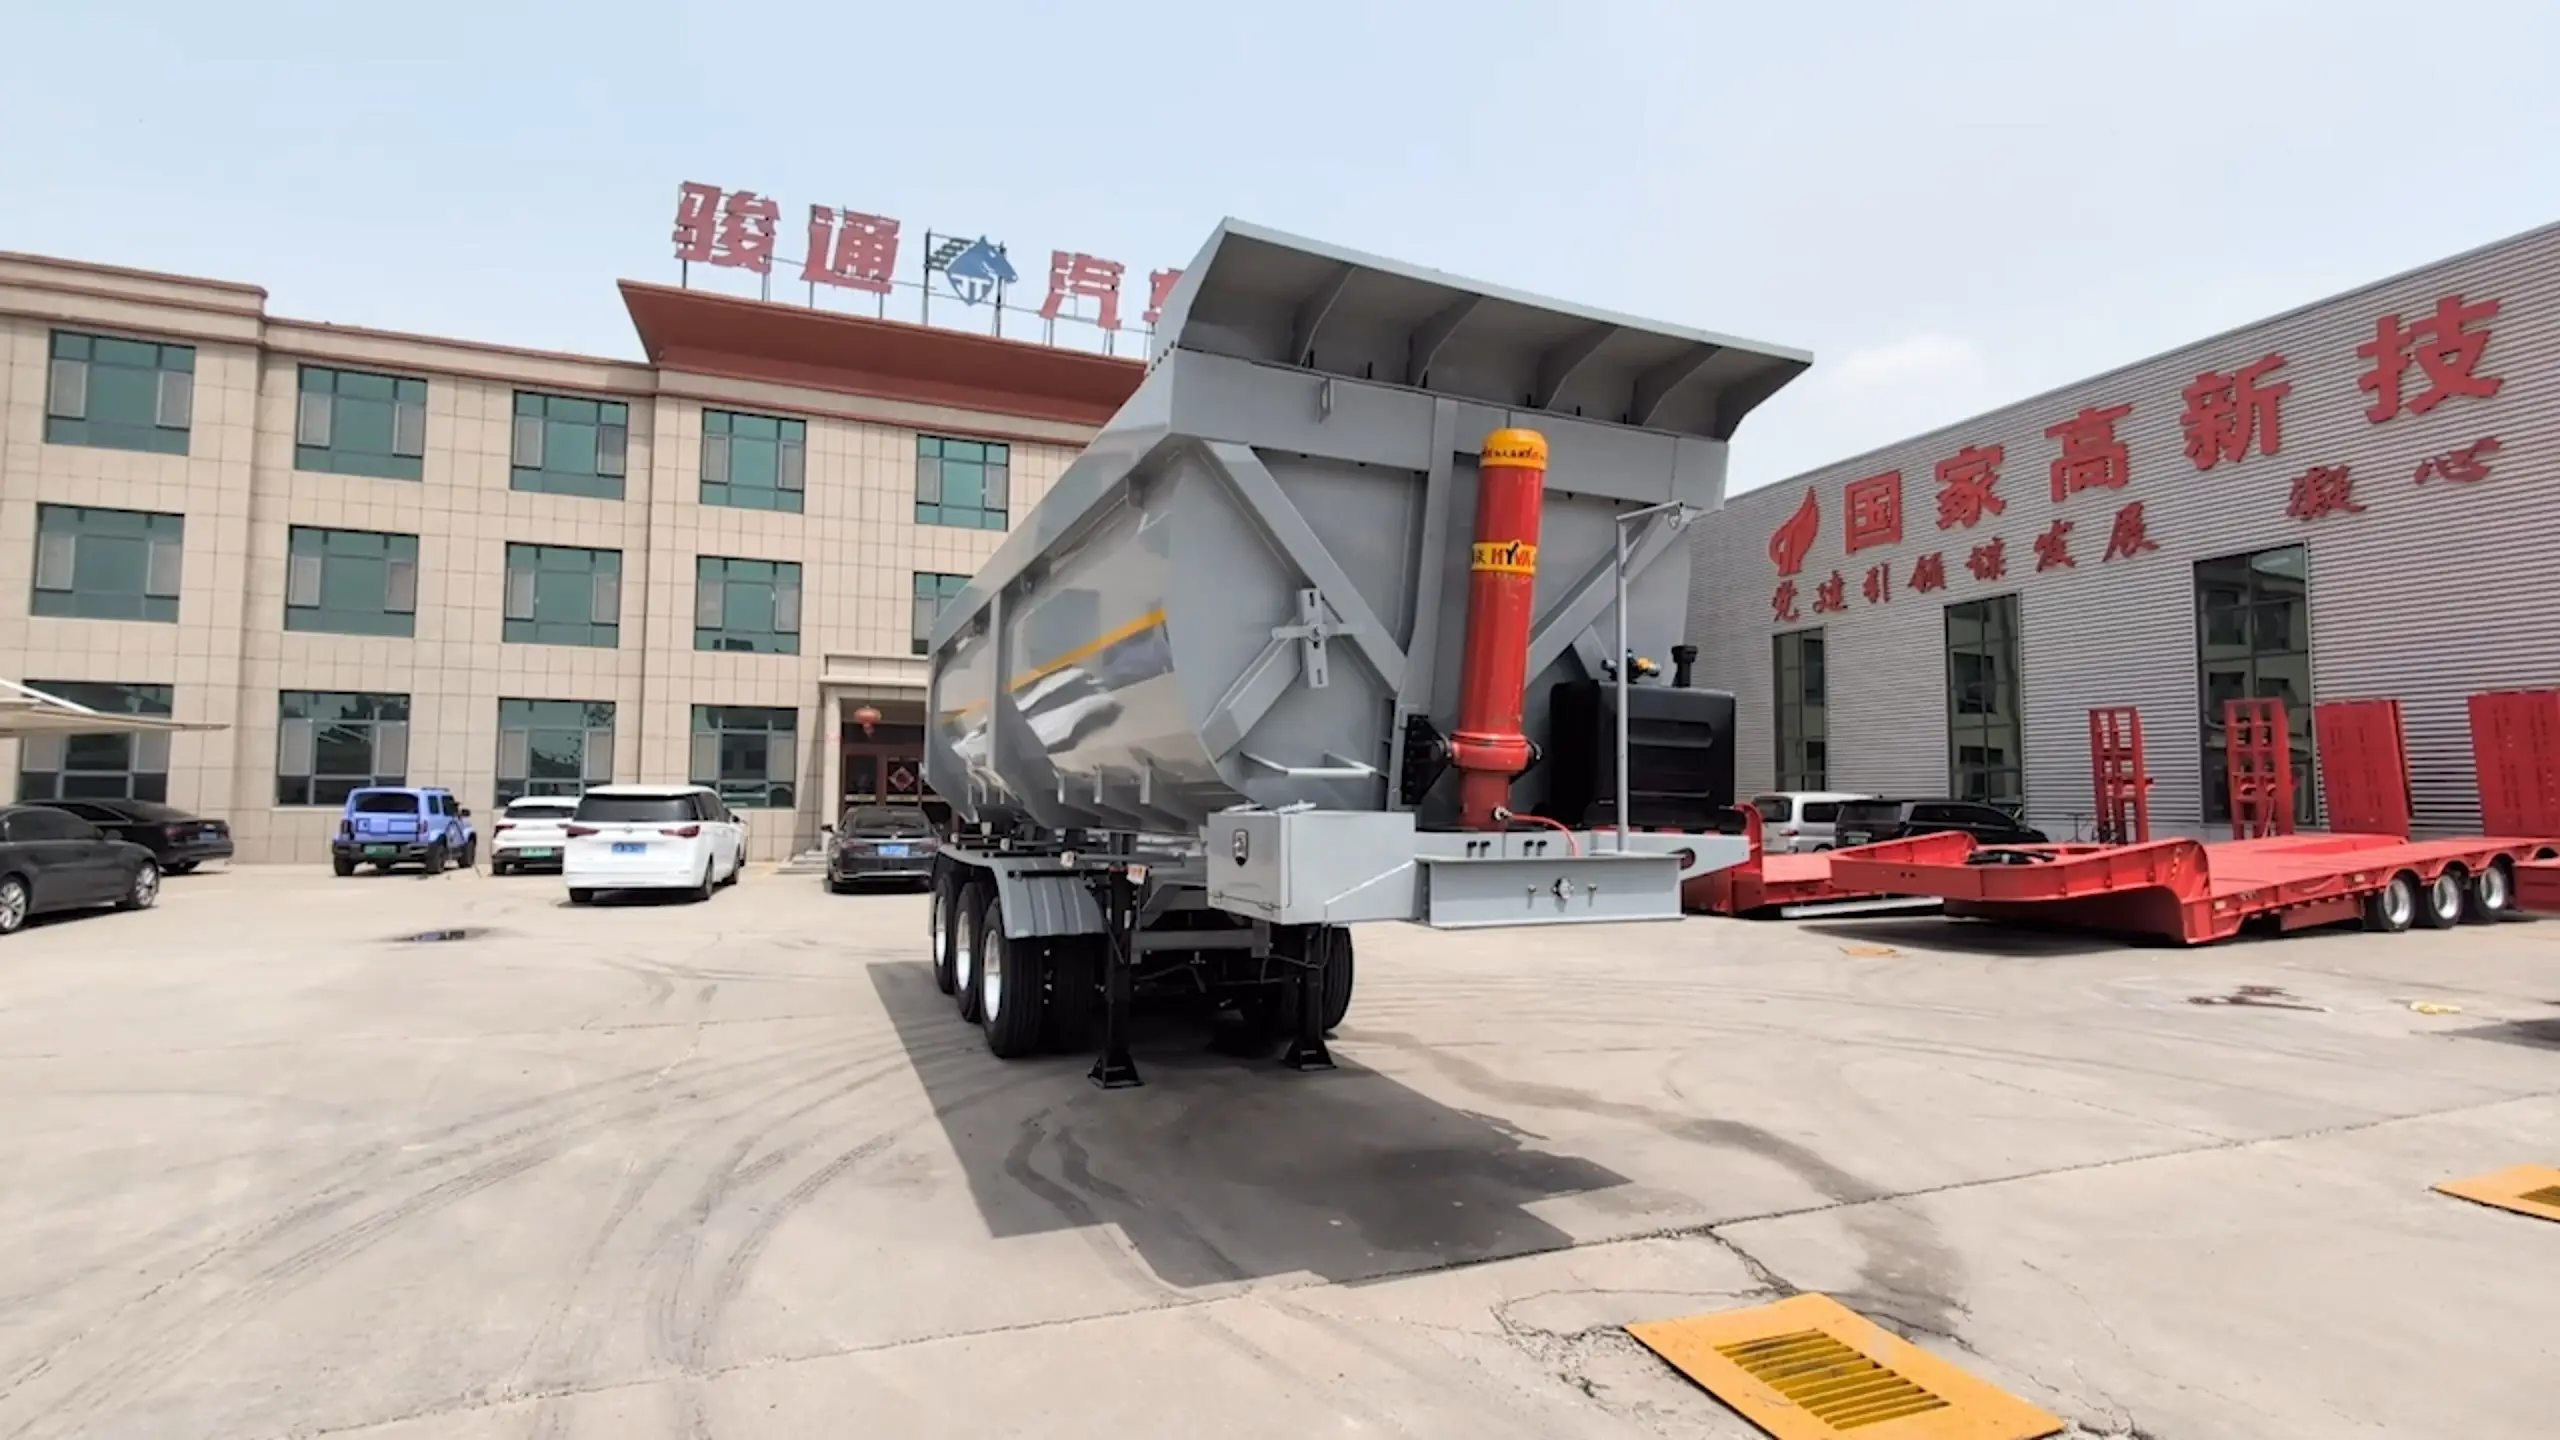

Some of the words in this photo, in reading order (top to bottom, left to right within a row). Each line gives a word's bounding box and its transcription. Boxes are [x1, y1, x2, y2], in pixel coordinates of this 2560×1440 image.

[673, 181, 900, 294] 骏通
[1844, 295, 2503, 556] 国家高新技
